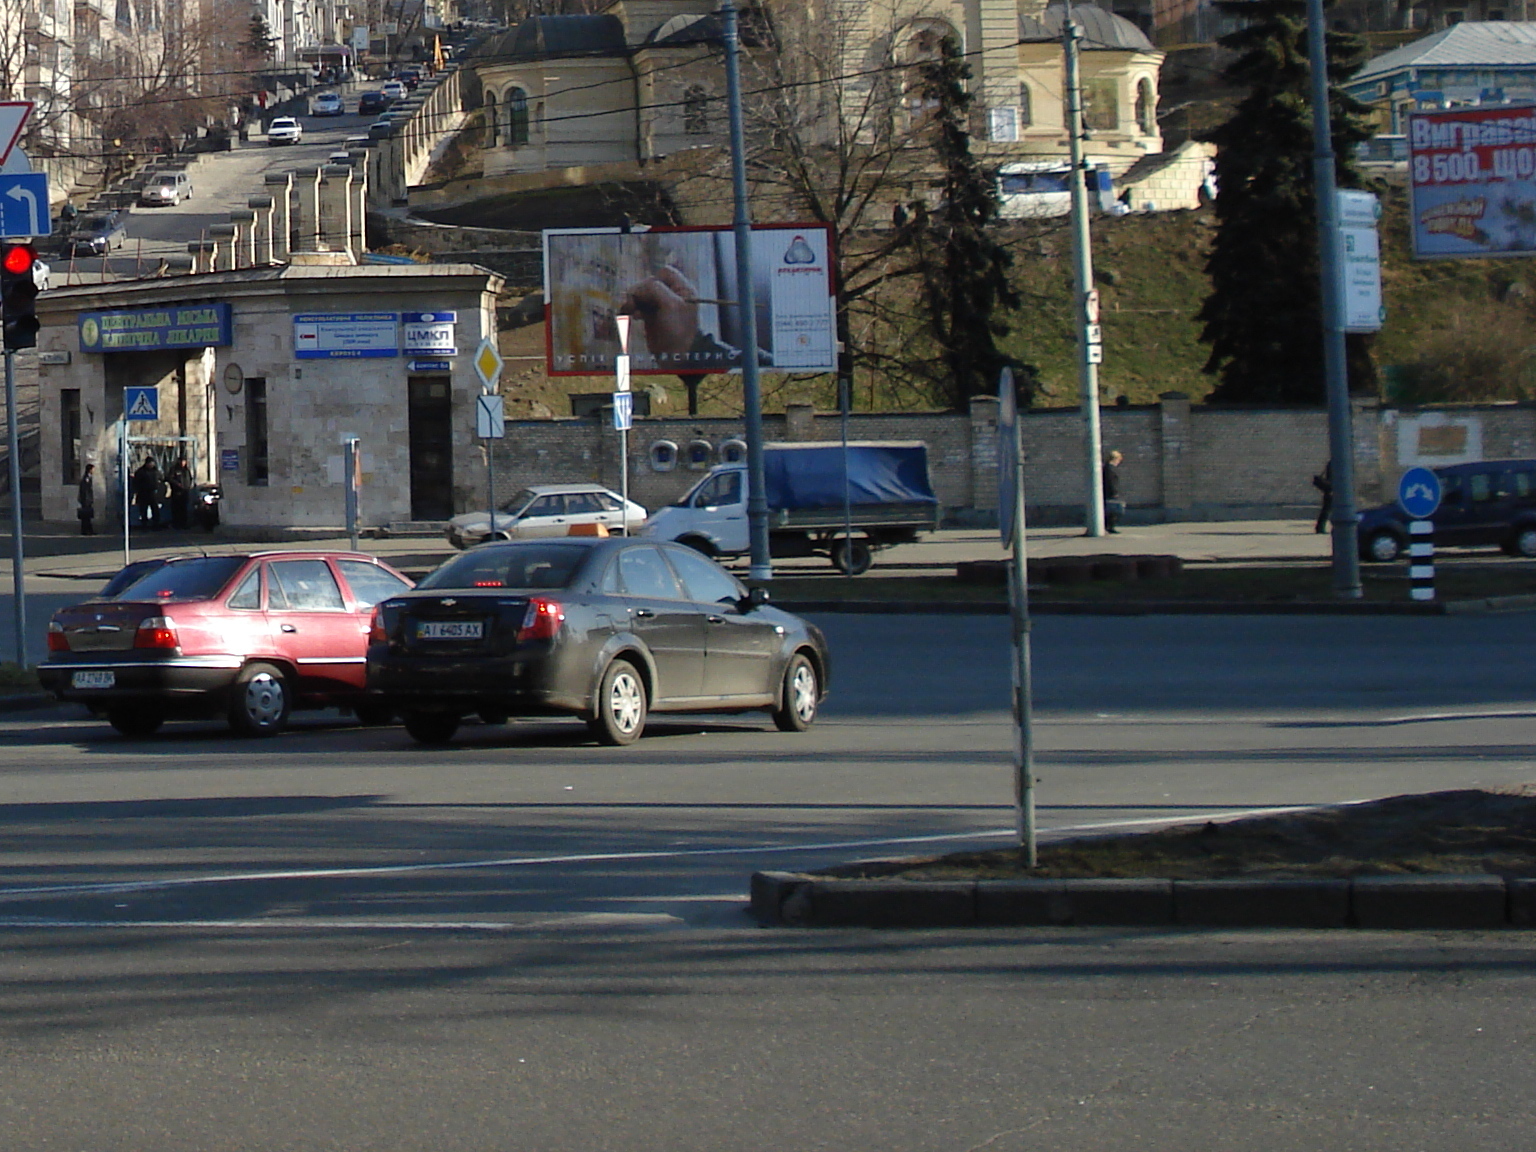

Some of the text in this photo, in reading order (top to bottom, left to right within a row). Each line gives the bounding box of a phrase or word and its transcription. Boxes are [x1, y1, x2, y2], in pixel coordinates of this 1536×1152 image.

[1493, 147, 1536, 181] що
[101, 312, 171, 330] ЦЕНТРАЛЬНА
[407, 330, 449, 342] ЦМКЛ
